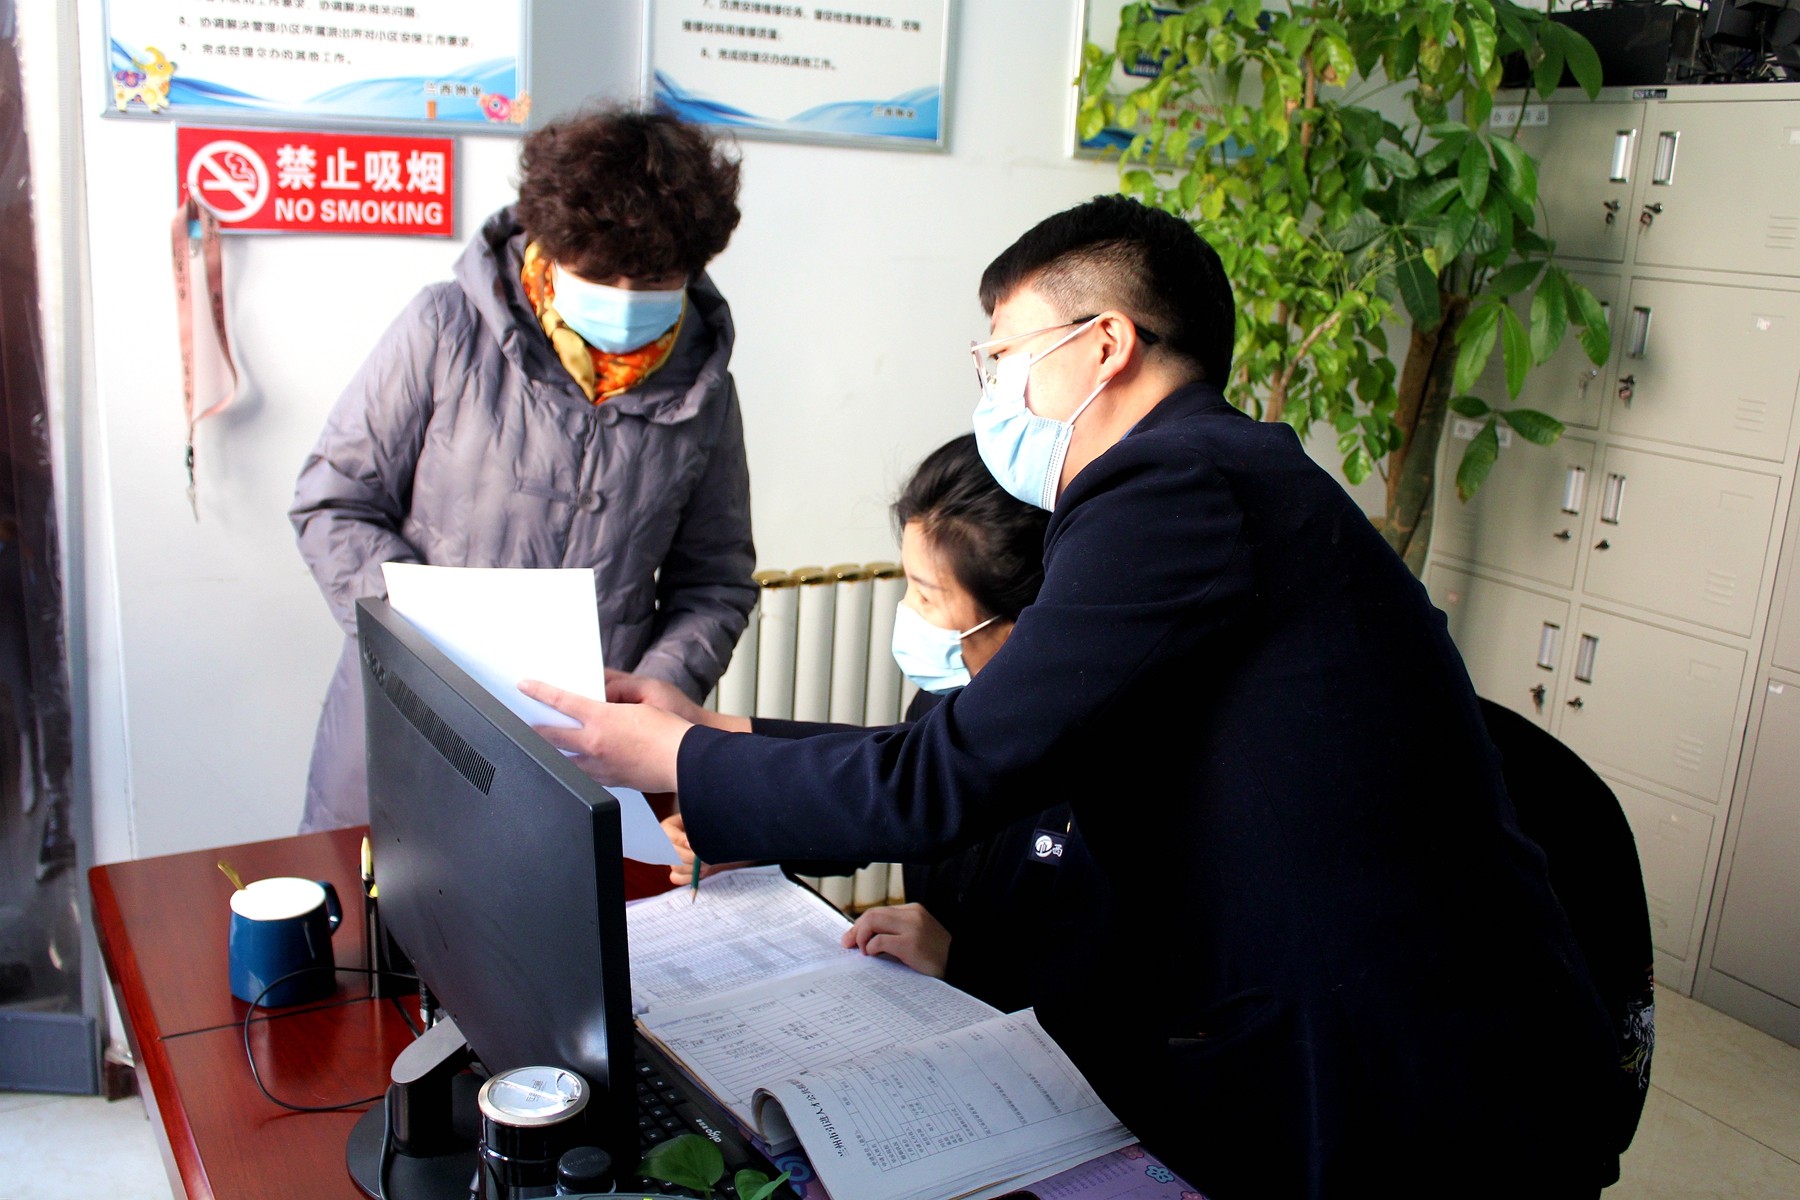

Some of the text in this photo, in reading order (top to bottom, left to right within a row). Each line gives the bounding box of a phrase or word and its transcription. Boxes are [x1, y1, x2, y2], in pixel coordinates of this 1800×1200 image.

[276, 144, 446, 195] 禁止吸烟
[274, 199, 444, 226] NO SMOKING
